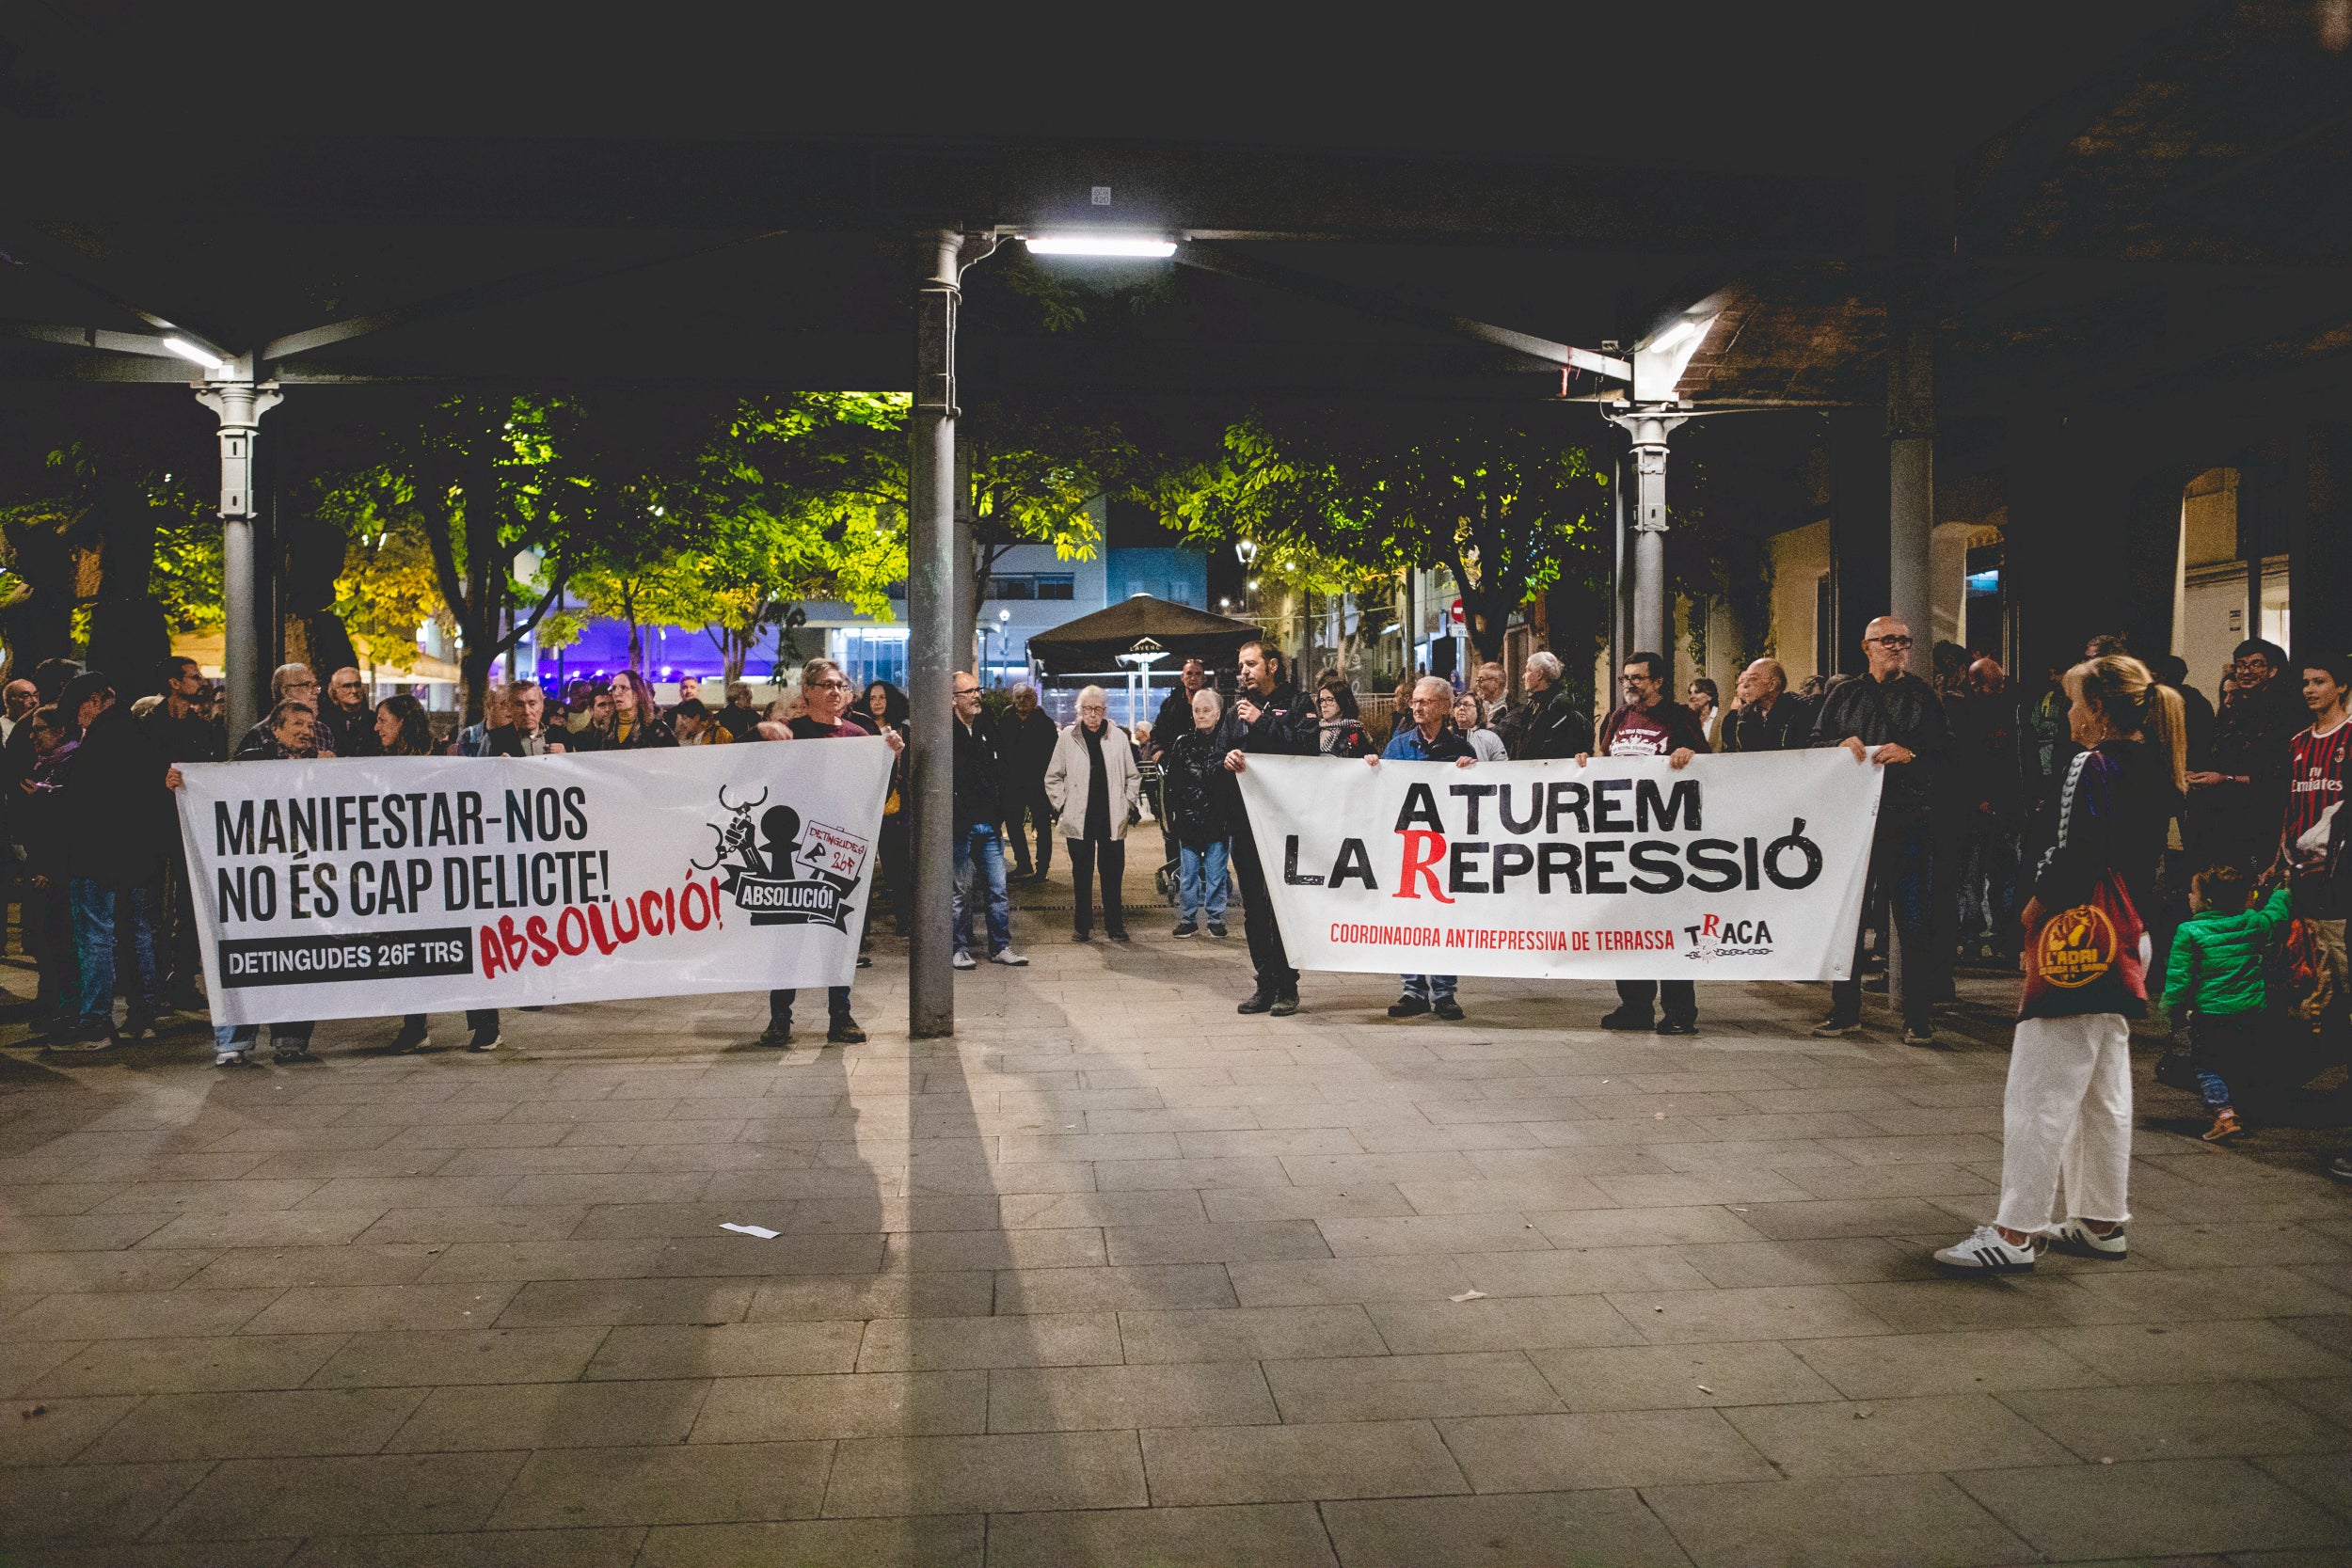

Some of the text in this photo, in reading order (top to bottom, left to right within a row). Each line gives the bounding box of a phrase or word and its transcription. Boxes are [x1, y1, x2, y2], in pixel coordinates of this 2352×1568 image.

[215, 786, 588, 857] MANIFESTAR-NOS
[1394, 779, 1703, 835] ATUREM
[809, 827, 865, 854] DETINGUDES
[831, 851, 855, 875] 26F
[1283, 816, 1823, 904] LA REPRESSIÓ
[217, 849, 612, 924] NO ÉS CAP DELICTE!
[741, 885, 834, 910] ABSOLUCIÓ!
[480, 867, 723, 980] ABSOLUCIÓ!
[1330, 923, 1675, 951] COORDINADORA ANTIREPRESSIVA DE TERRASSA
[1684, 913, 1773, 946] TRACA
[229, 940, 464, 974] DETINGUDES 26F TRS
